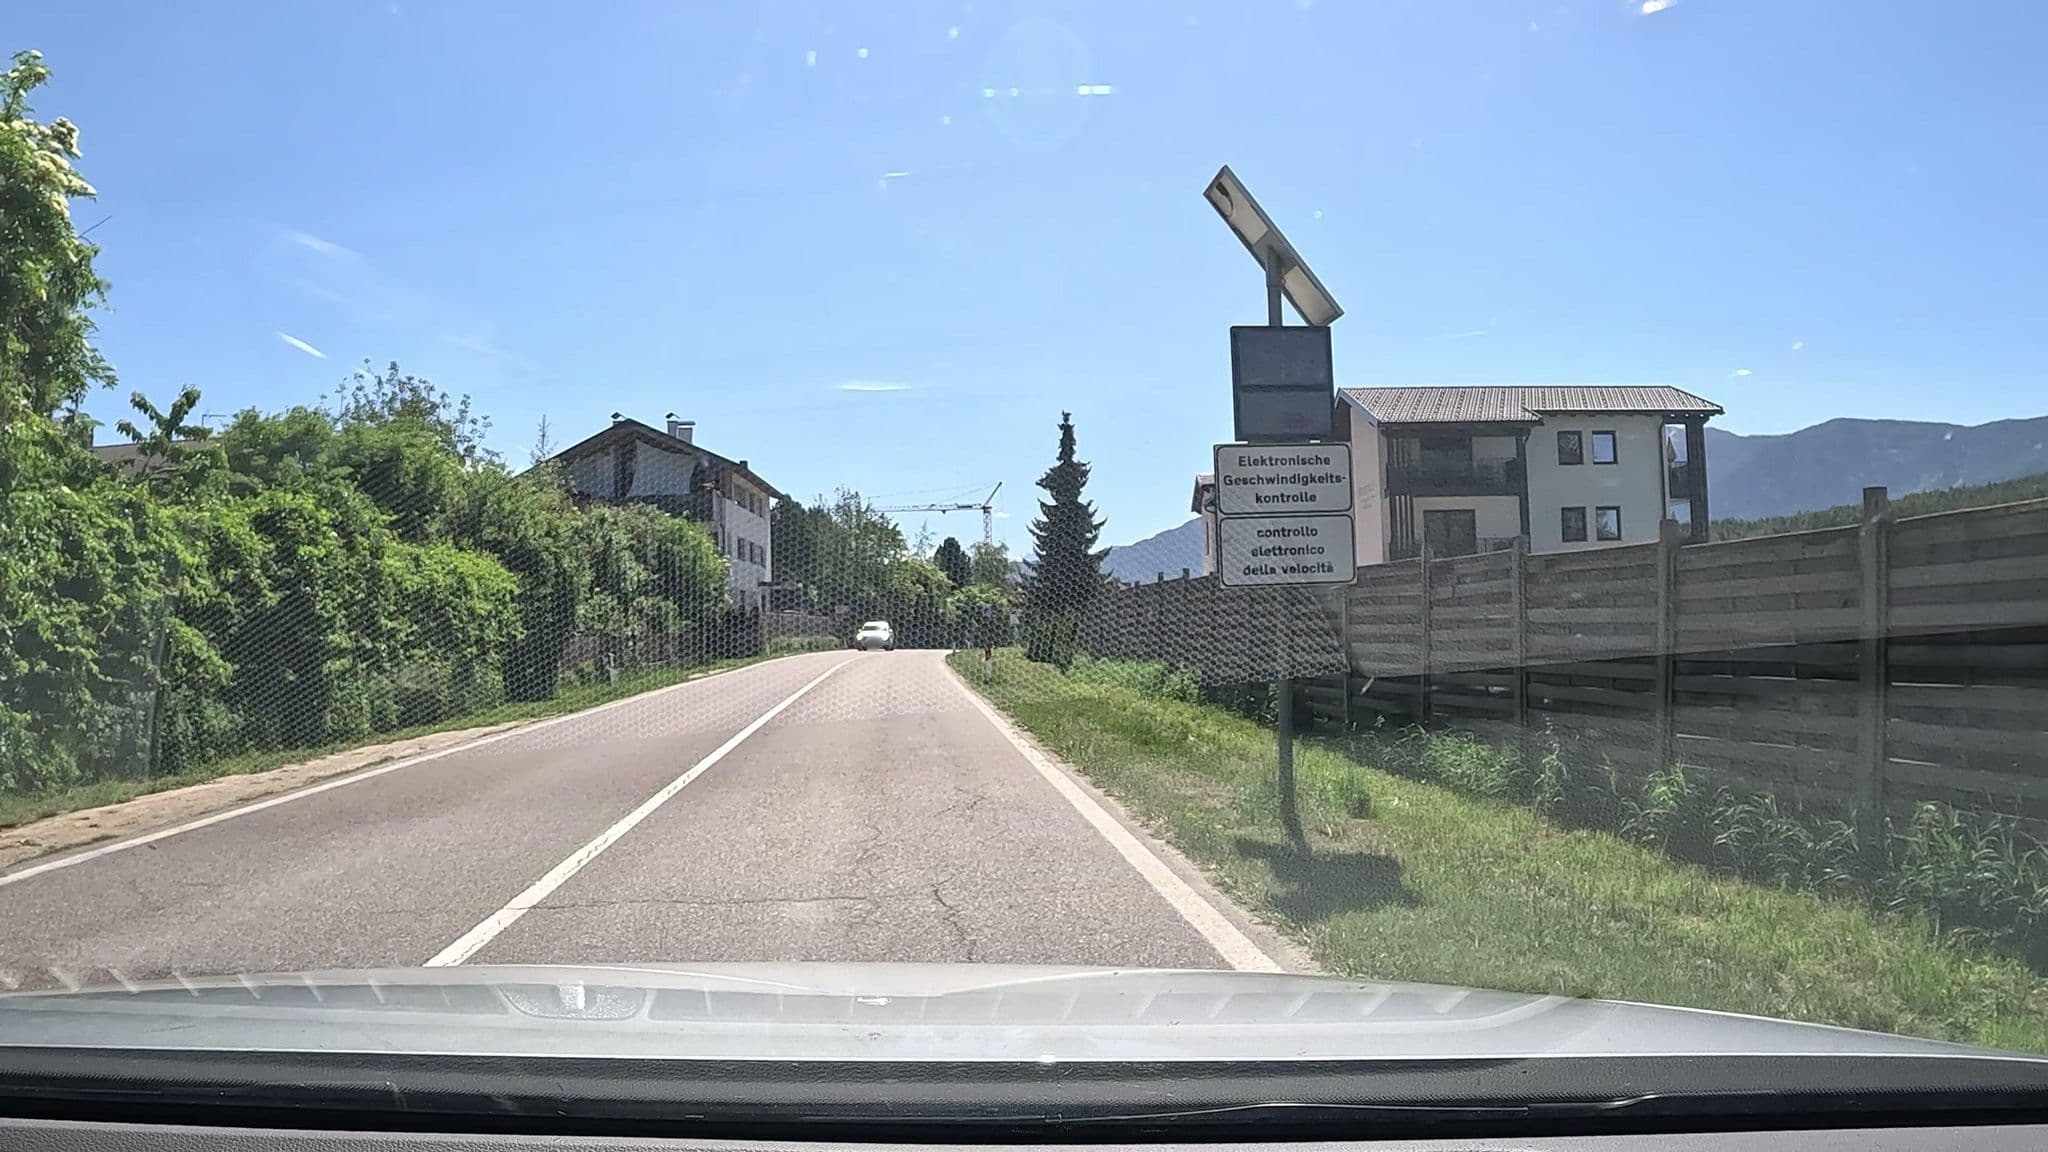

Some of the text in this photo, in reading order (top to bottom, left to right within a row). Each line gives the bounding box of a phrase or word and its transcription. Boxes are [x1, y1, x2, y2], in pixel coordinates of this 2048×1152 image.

[1238, 454, 1331, 467] Elektronische
[1223, 472, 1347, 486] Geschwindigkeits-
[1255, 491, 1317, 504] kontrolle
[1256, 526, 1318, 538] controllo
[1250, 544, 1325, 557] elettronico
[1242, 561, 1334, 576] della velocità
